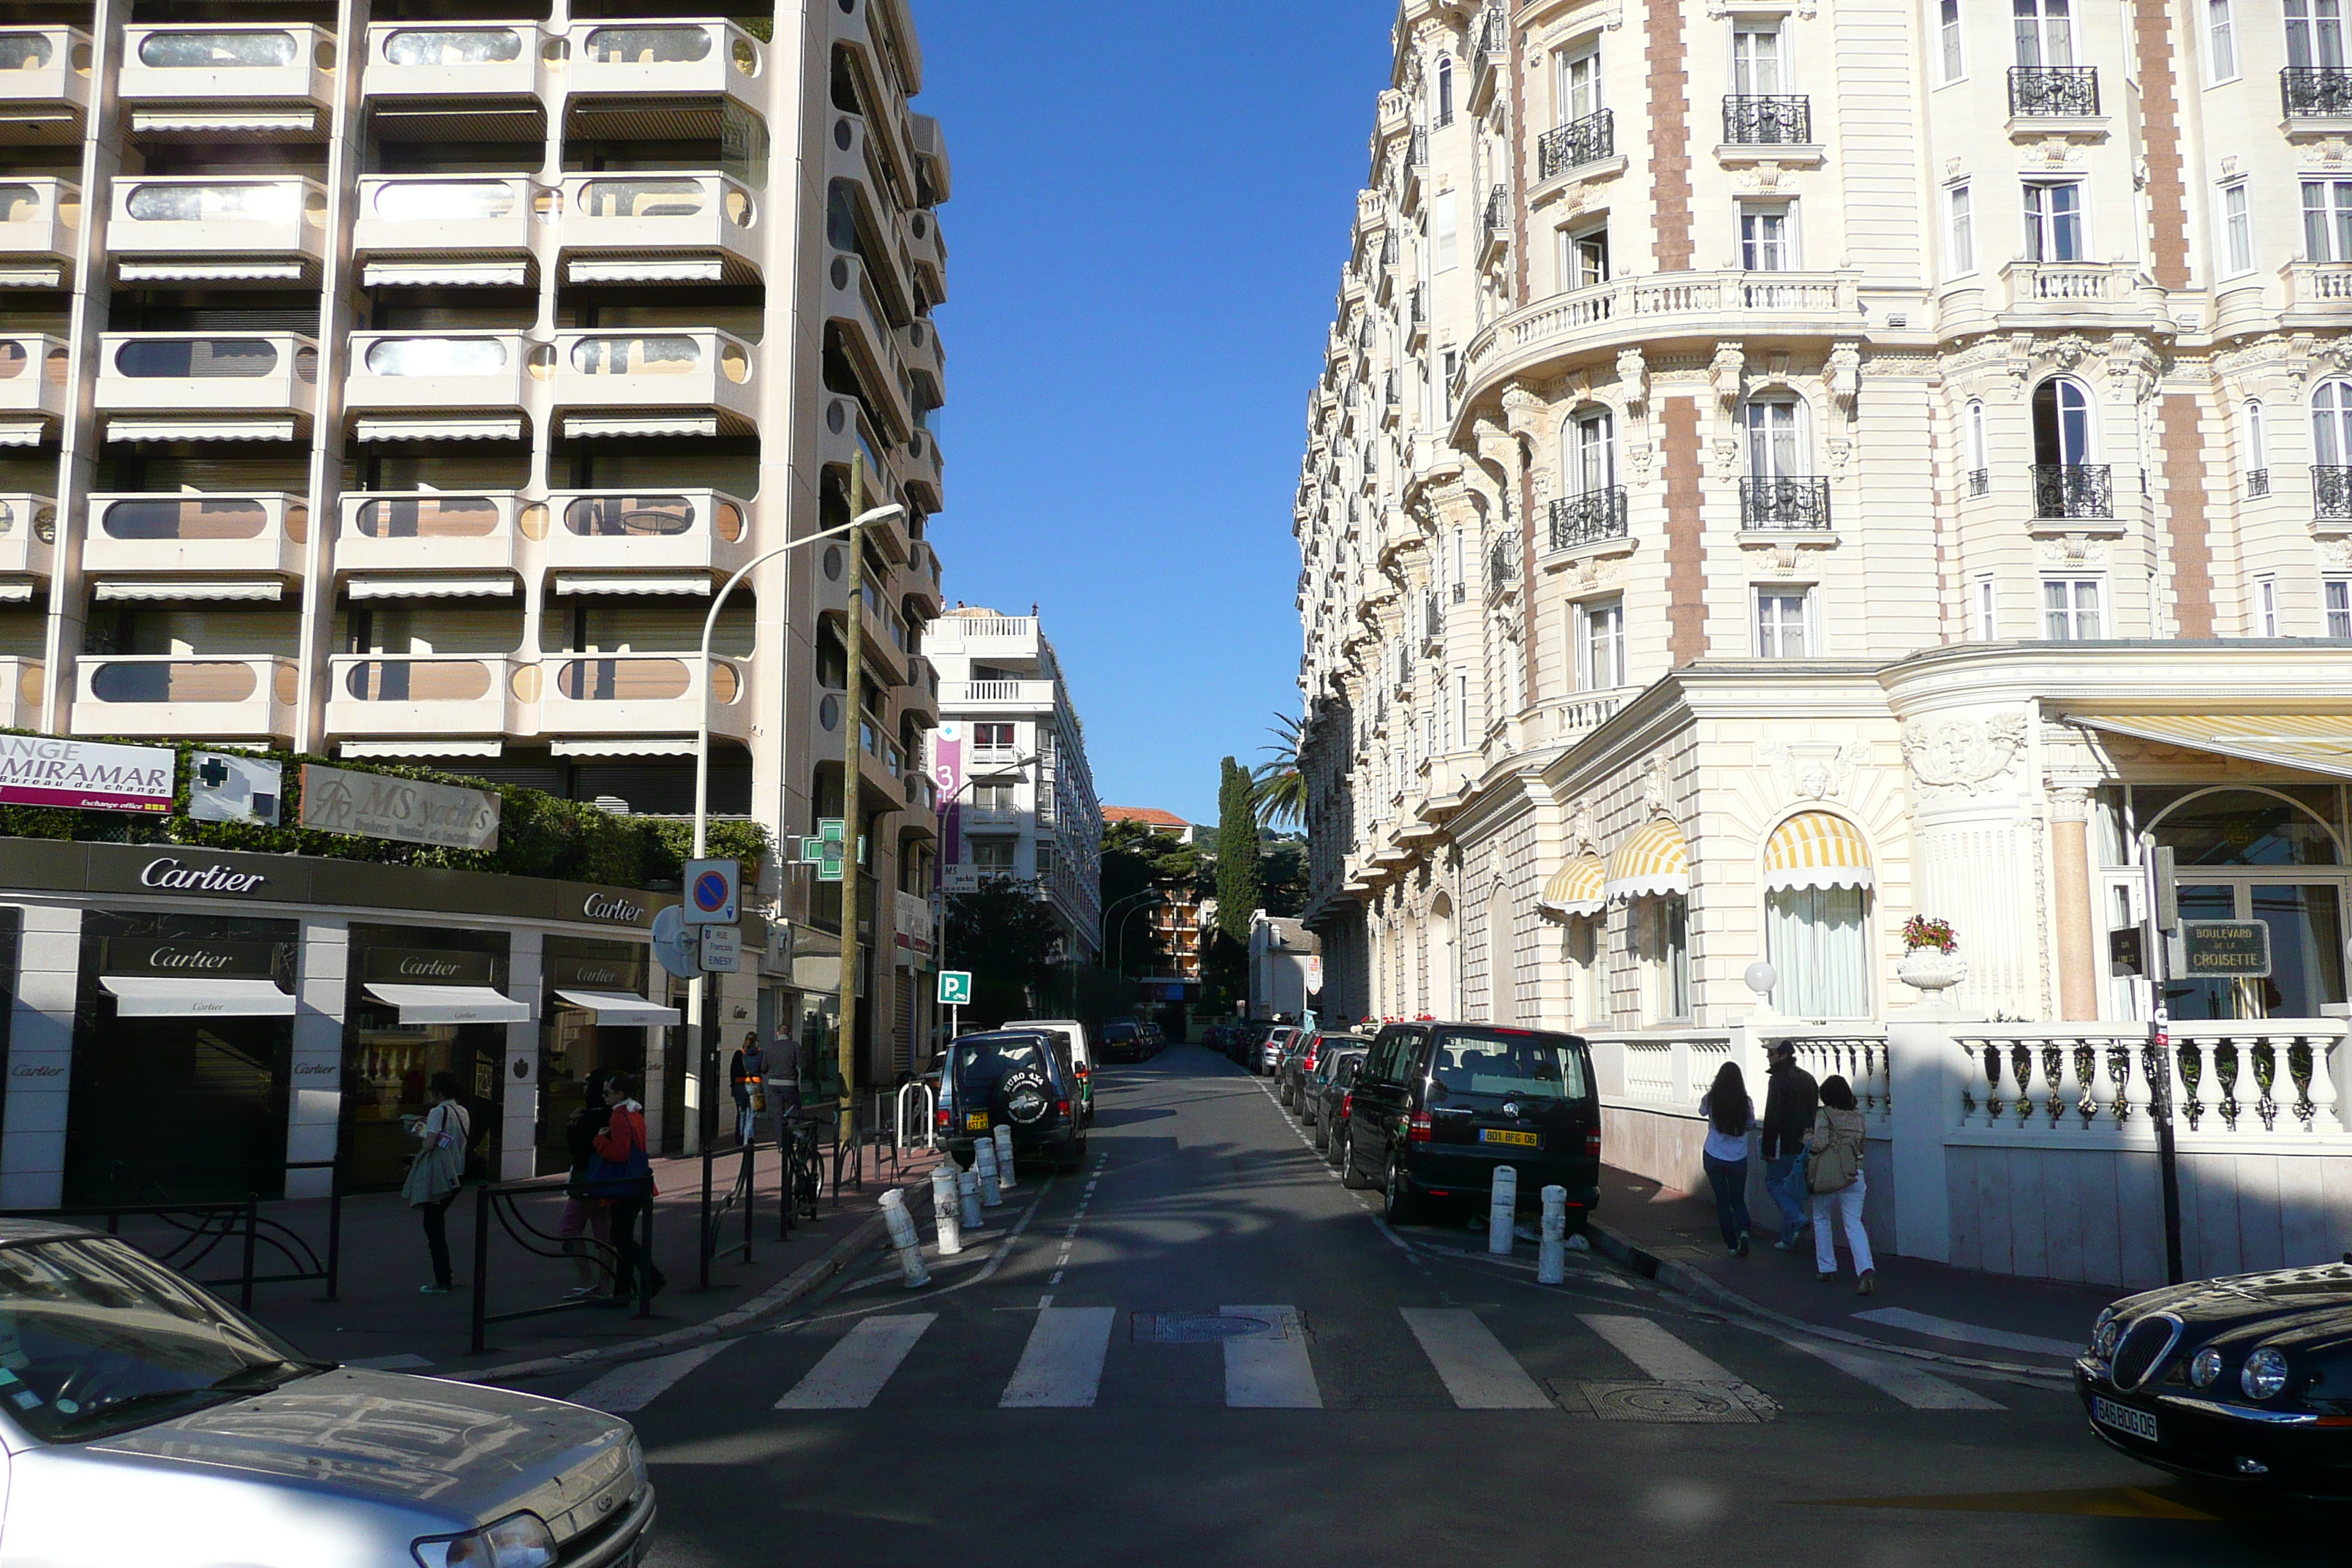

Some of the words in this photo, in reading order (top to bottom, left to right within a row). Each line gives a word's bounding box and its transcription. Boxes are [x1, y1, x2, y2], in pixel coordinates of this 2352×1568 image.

[0, 758, 166, 787] MIRAMAR
[936, 765, 954, 790] 3
[0, 775, 63, 787] Bureau
[75, 781, 94, 789] de
[104, 784, 166, 795] change
[81, 799, 119, 808] Exchange
[355, 781, 417, 820] MS
[418, 797, 489, 830] yachts
[141, 858, 265, 892] Cartier
[944, 866, 957, 875] MS
[584, 892, 644, 921] Cartier
[717, 931, 728, 940] RUE
[2195, 928, 2252, 939] BOULEVARD
[150, 946, 233, 968] Cartier
[2193, 953, 2258, 967] CROISETTE
[400, 956, 461, 976] Cartier
[577, 965, 616, 984] Cartier
[945, 976, 960, 998] P
[192, 1002, 225, 1011] Cartier
[454, 1011, 477, 1019] Cartier
[12, 1063, 64, 1077] Cartier
[294, 1062, 336, 1074] Cartier
[1003, 1072, 1025, 1093] EURO
[1028, 1072, 1044, 1085] 4X4
[972, 1112, 984, 1120] 224
[968, 1121, 979, 1130] AST
[1486, 1131, 1501, 1142] 801
[1505, 1133, 1520, 1143] BFG
[1524, 1134, 1535, 1145] 06
[2117, 1406, 2138, 1432] BDG
[2139, 1414, 2155, 1438] 06
